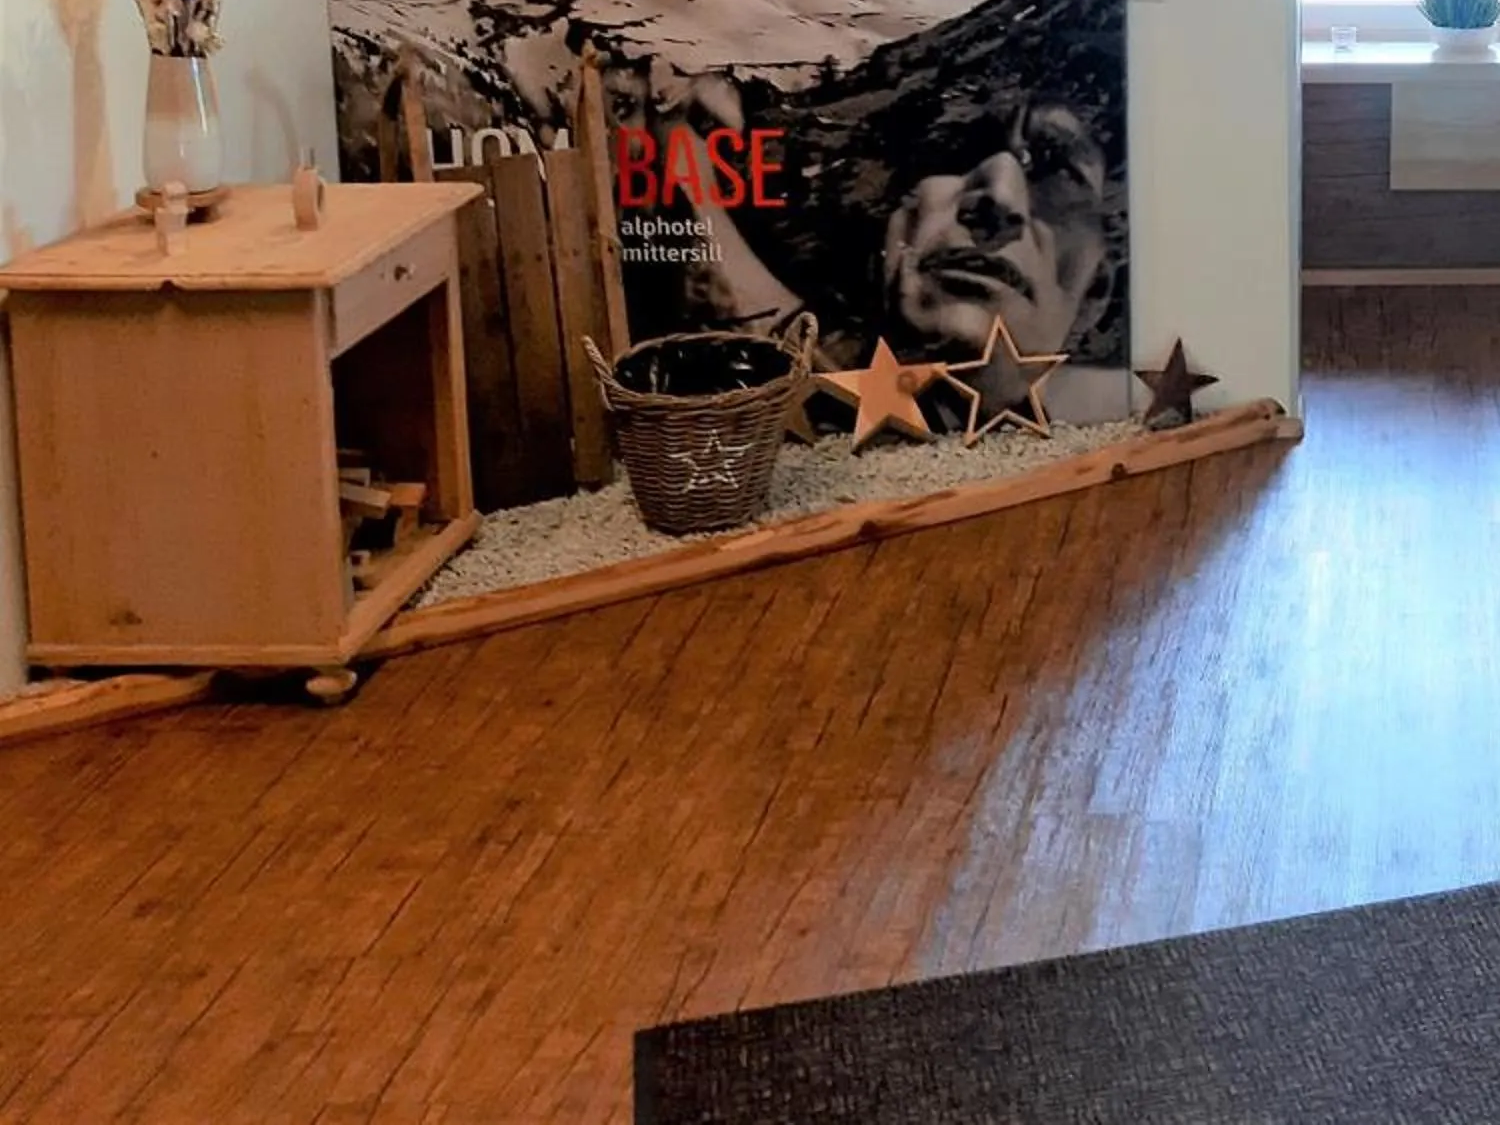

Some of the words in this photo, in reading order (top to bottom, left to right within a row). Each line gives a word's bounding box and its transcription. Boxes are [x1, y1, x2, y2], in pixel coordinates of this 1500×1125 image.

[617, 127, 787, 208] BASE
[620, 216, 714, 237] alphotel
[622, 243, 723, 263] mittersill
